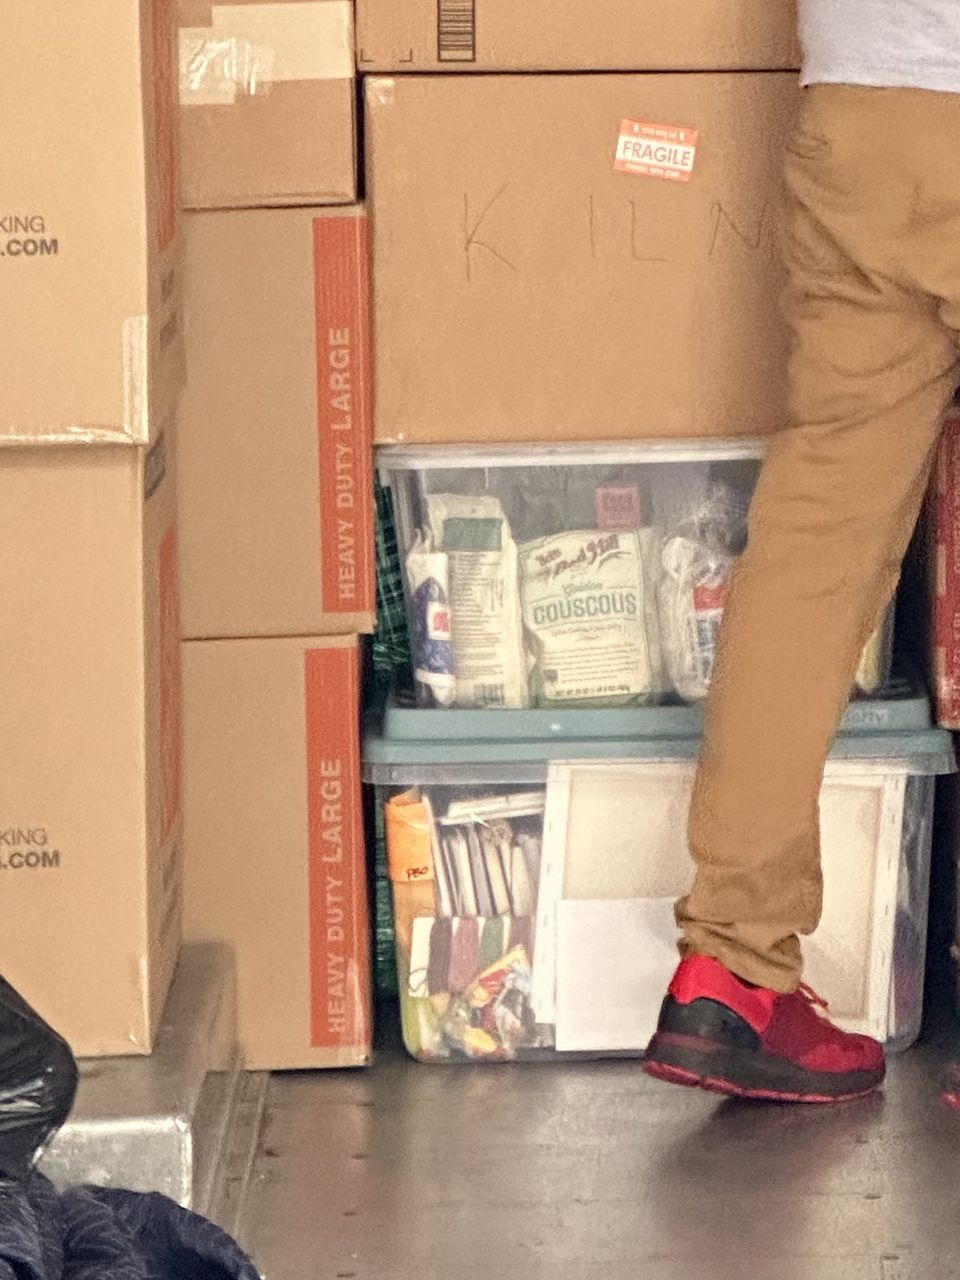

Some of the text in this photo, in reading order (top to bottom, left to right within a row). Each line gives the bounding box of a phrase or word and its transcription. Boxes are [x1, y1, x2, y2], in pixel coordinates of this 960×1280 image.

[622, 140, 691, 167] FRAGILE
[0, 215, 45, 233] KING
[328, 327, 355, 600] HEAVY DUTY LARGE
[533, 592, 637, 625] COUSCOUS
[0, 850, 60, 869] .COM
[319, 759, 346, 1034] HEAVY DUTY LARGE
